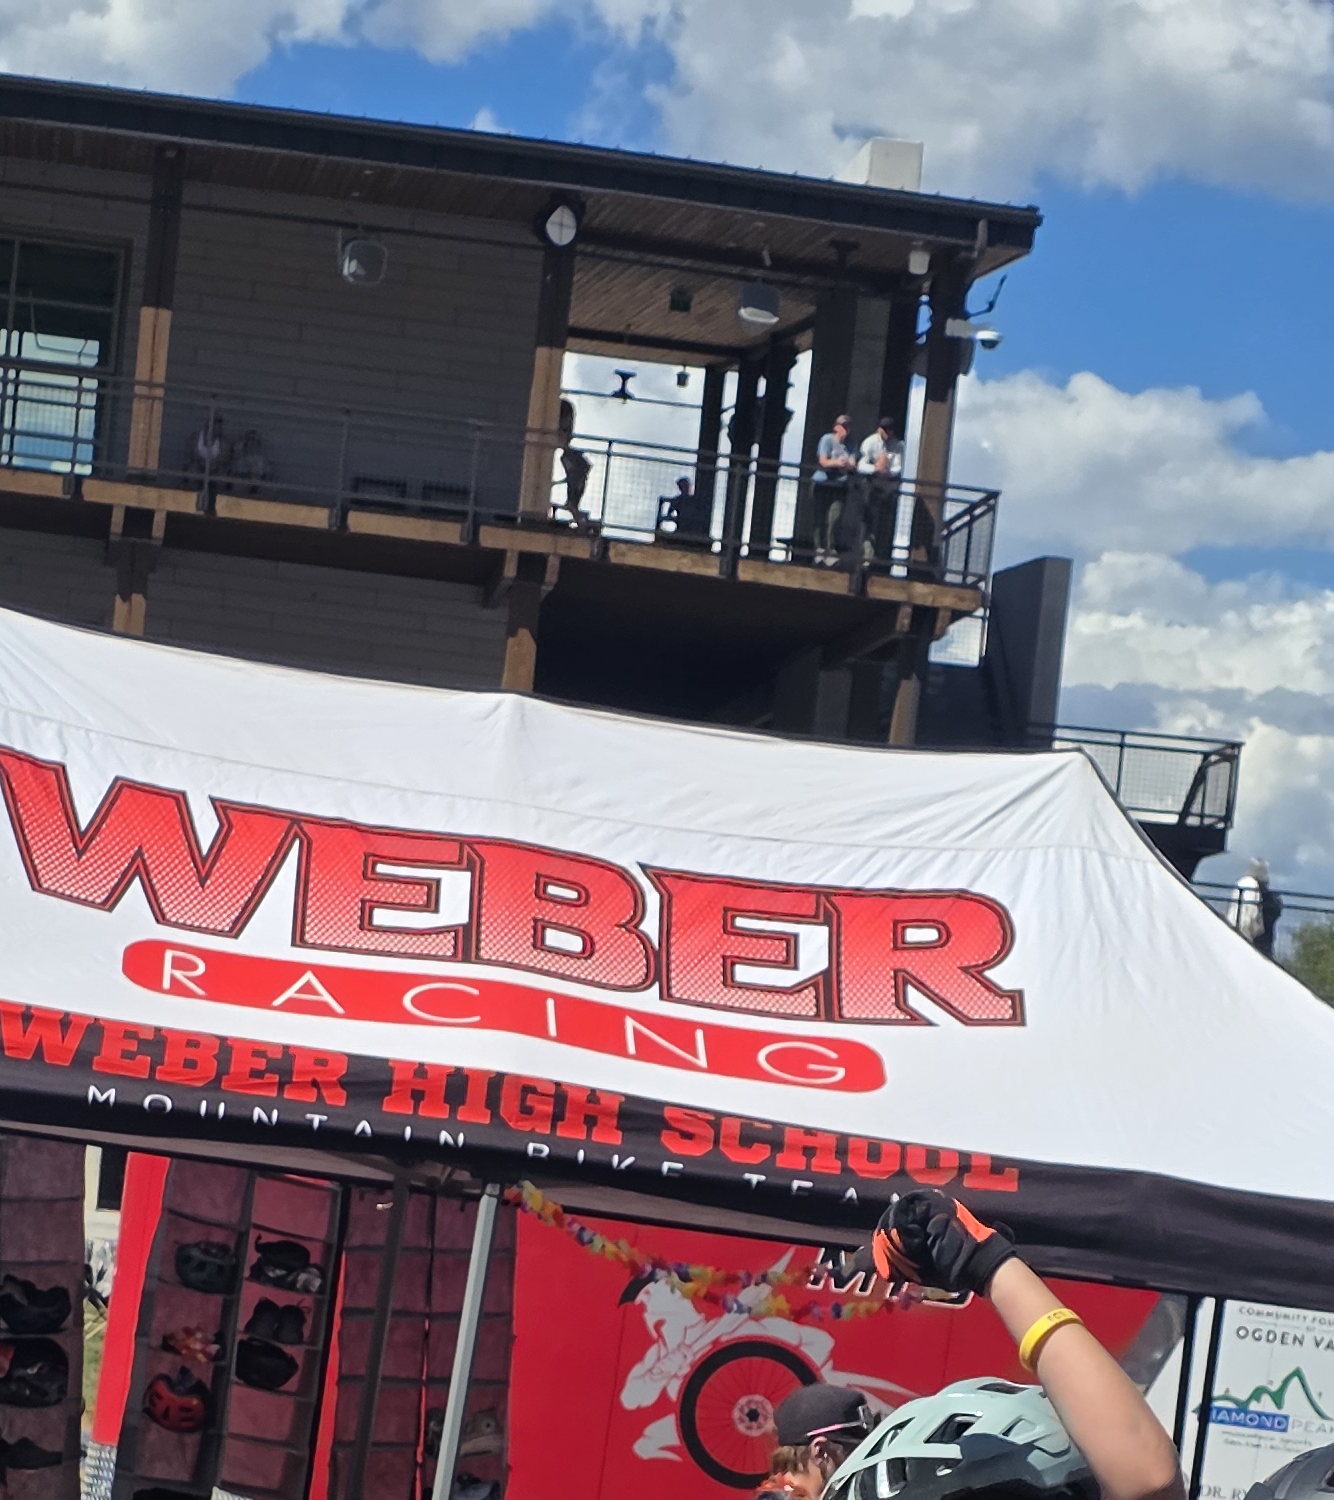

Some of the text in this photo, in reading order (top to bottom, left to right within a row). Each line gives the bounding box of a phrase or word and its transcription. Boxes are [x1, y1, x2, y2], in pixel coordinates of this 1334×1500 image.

[156, 947, 847, 1086] RACING
[382, 1058, 624, 1145] HIGH
[661, 1106, 1019, 1192] SCHOOL
[1238, 1306, 1308, 1323] COMMUNITY
[1236, 1325, 1305, 1347] OGDEN
[1209, 1407, 1288, 1431] IAMOND
